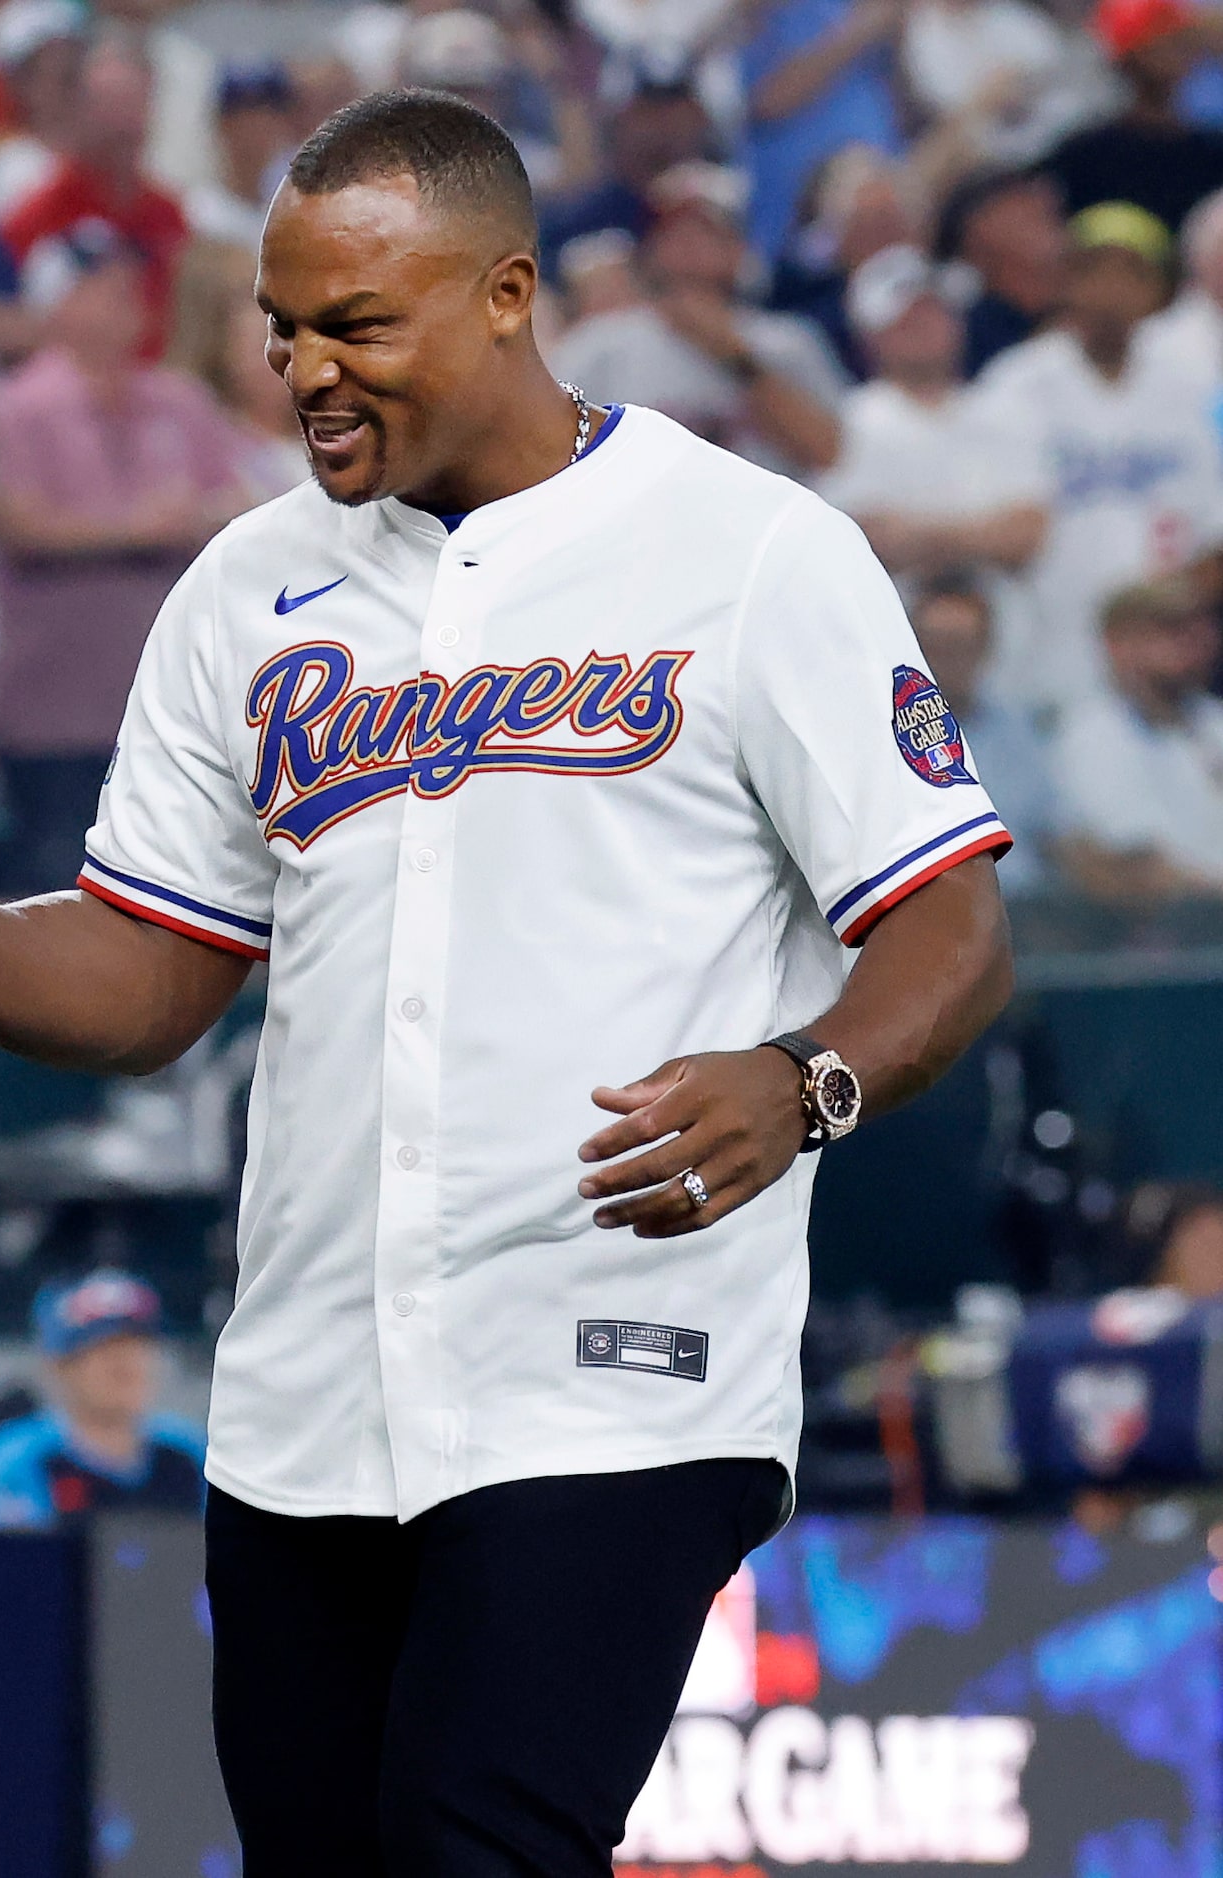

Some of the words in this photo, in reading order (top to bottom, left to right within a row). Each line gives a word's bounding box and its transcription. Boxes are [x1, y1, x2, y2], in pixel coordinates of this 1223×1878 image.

[245, 640, 695, 852] Rangers
[909, 719, 949, 751] GAME
[745, 1705, 1035, 1866] GAME
